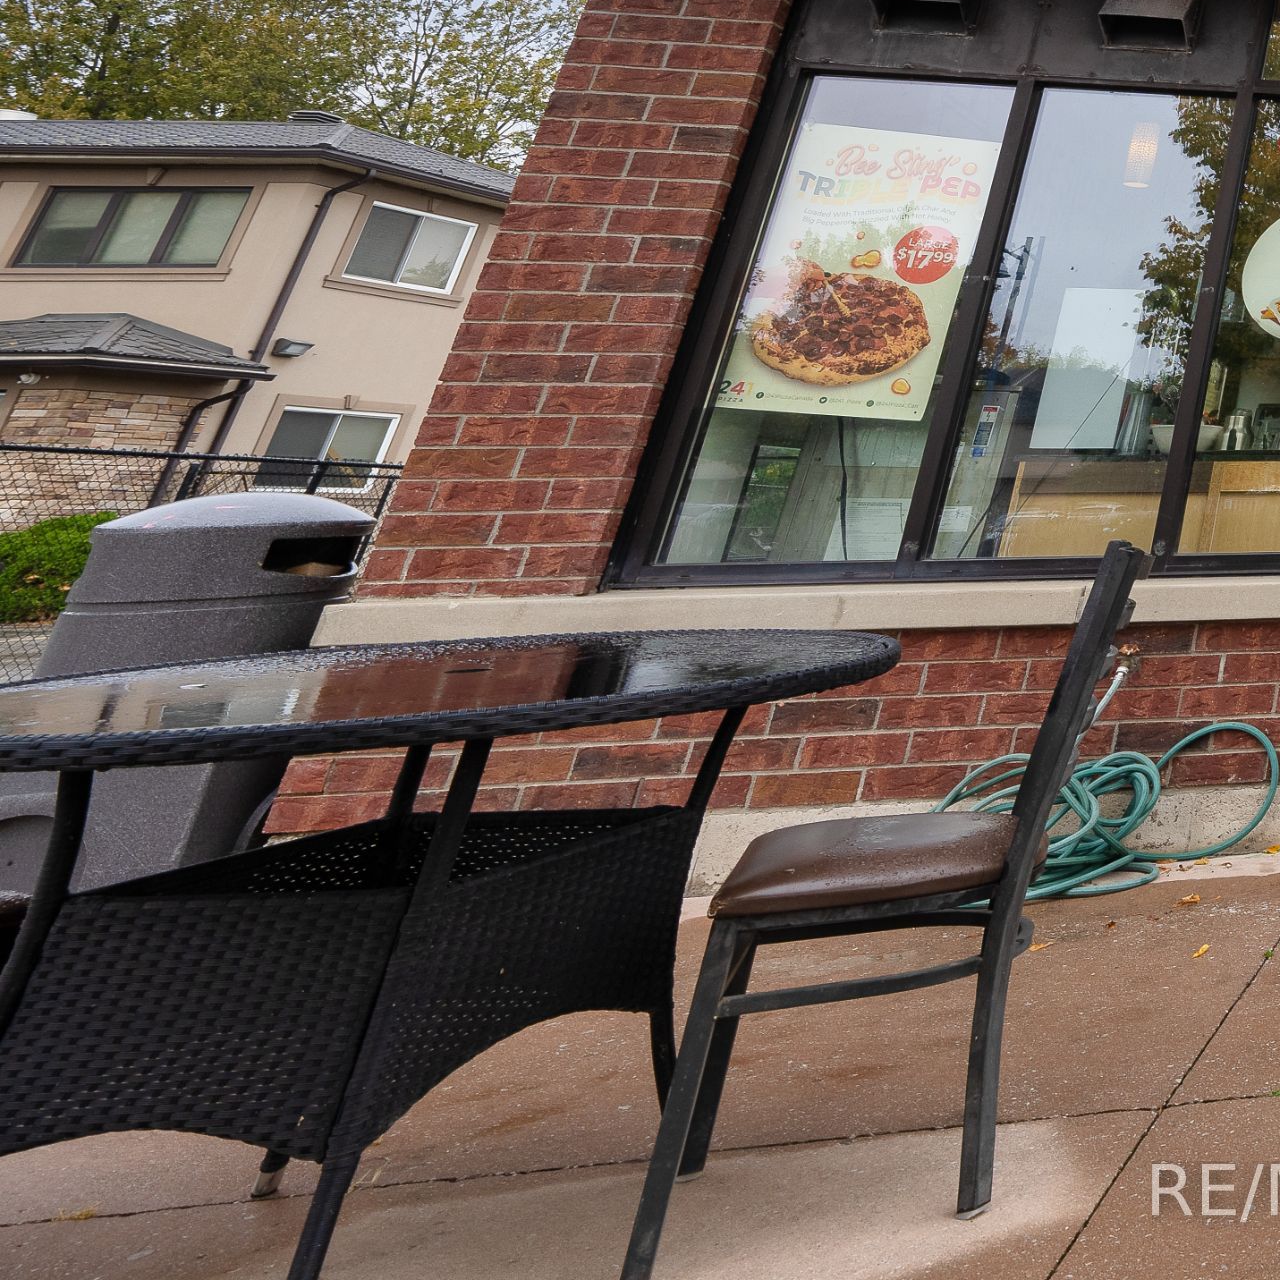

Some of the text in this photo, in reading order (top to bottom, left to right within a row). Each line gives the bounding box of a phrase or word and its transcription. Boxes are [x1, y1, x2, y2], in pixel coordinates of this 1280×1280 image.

[835, 144, 881, 177] Bee
[920, 175, 981, 199] PEP
[909, 237, 952, 249] LARGE
